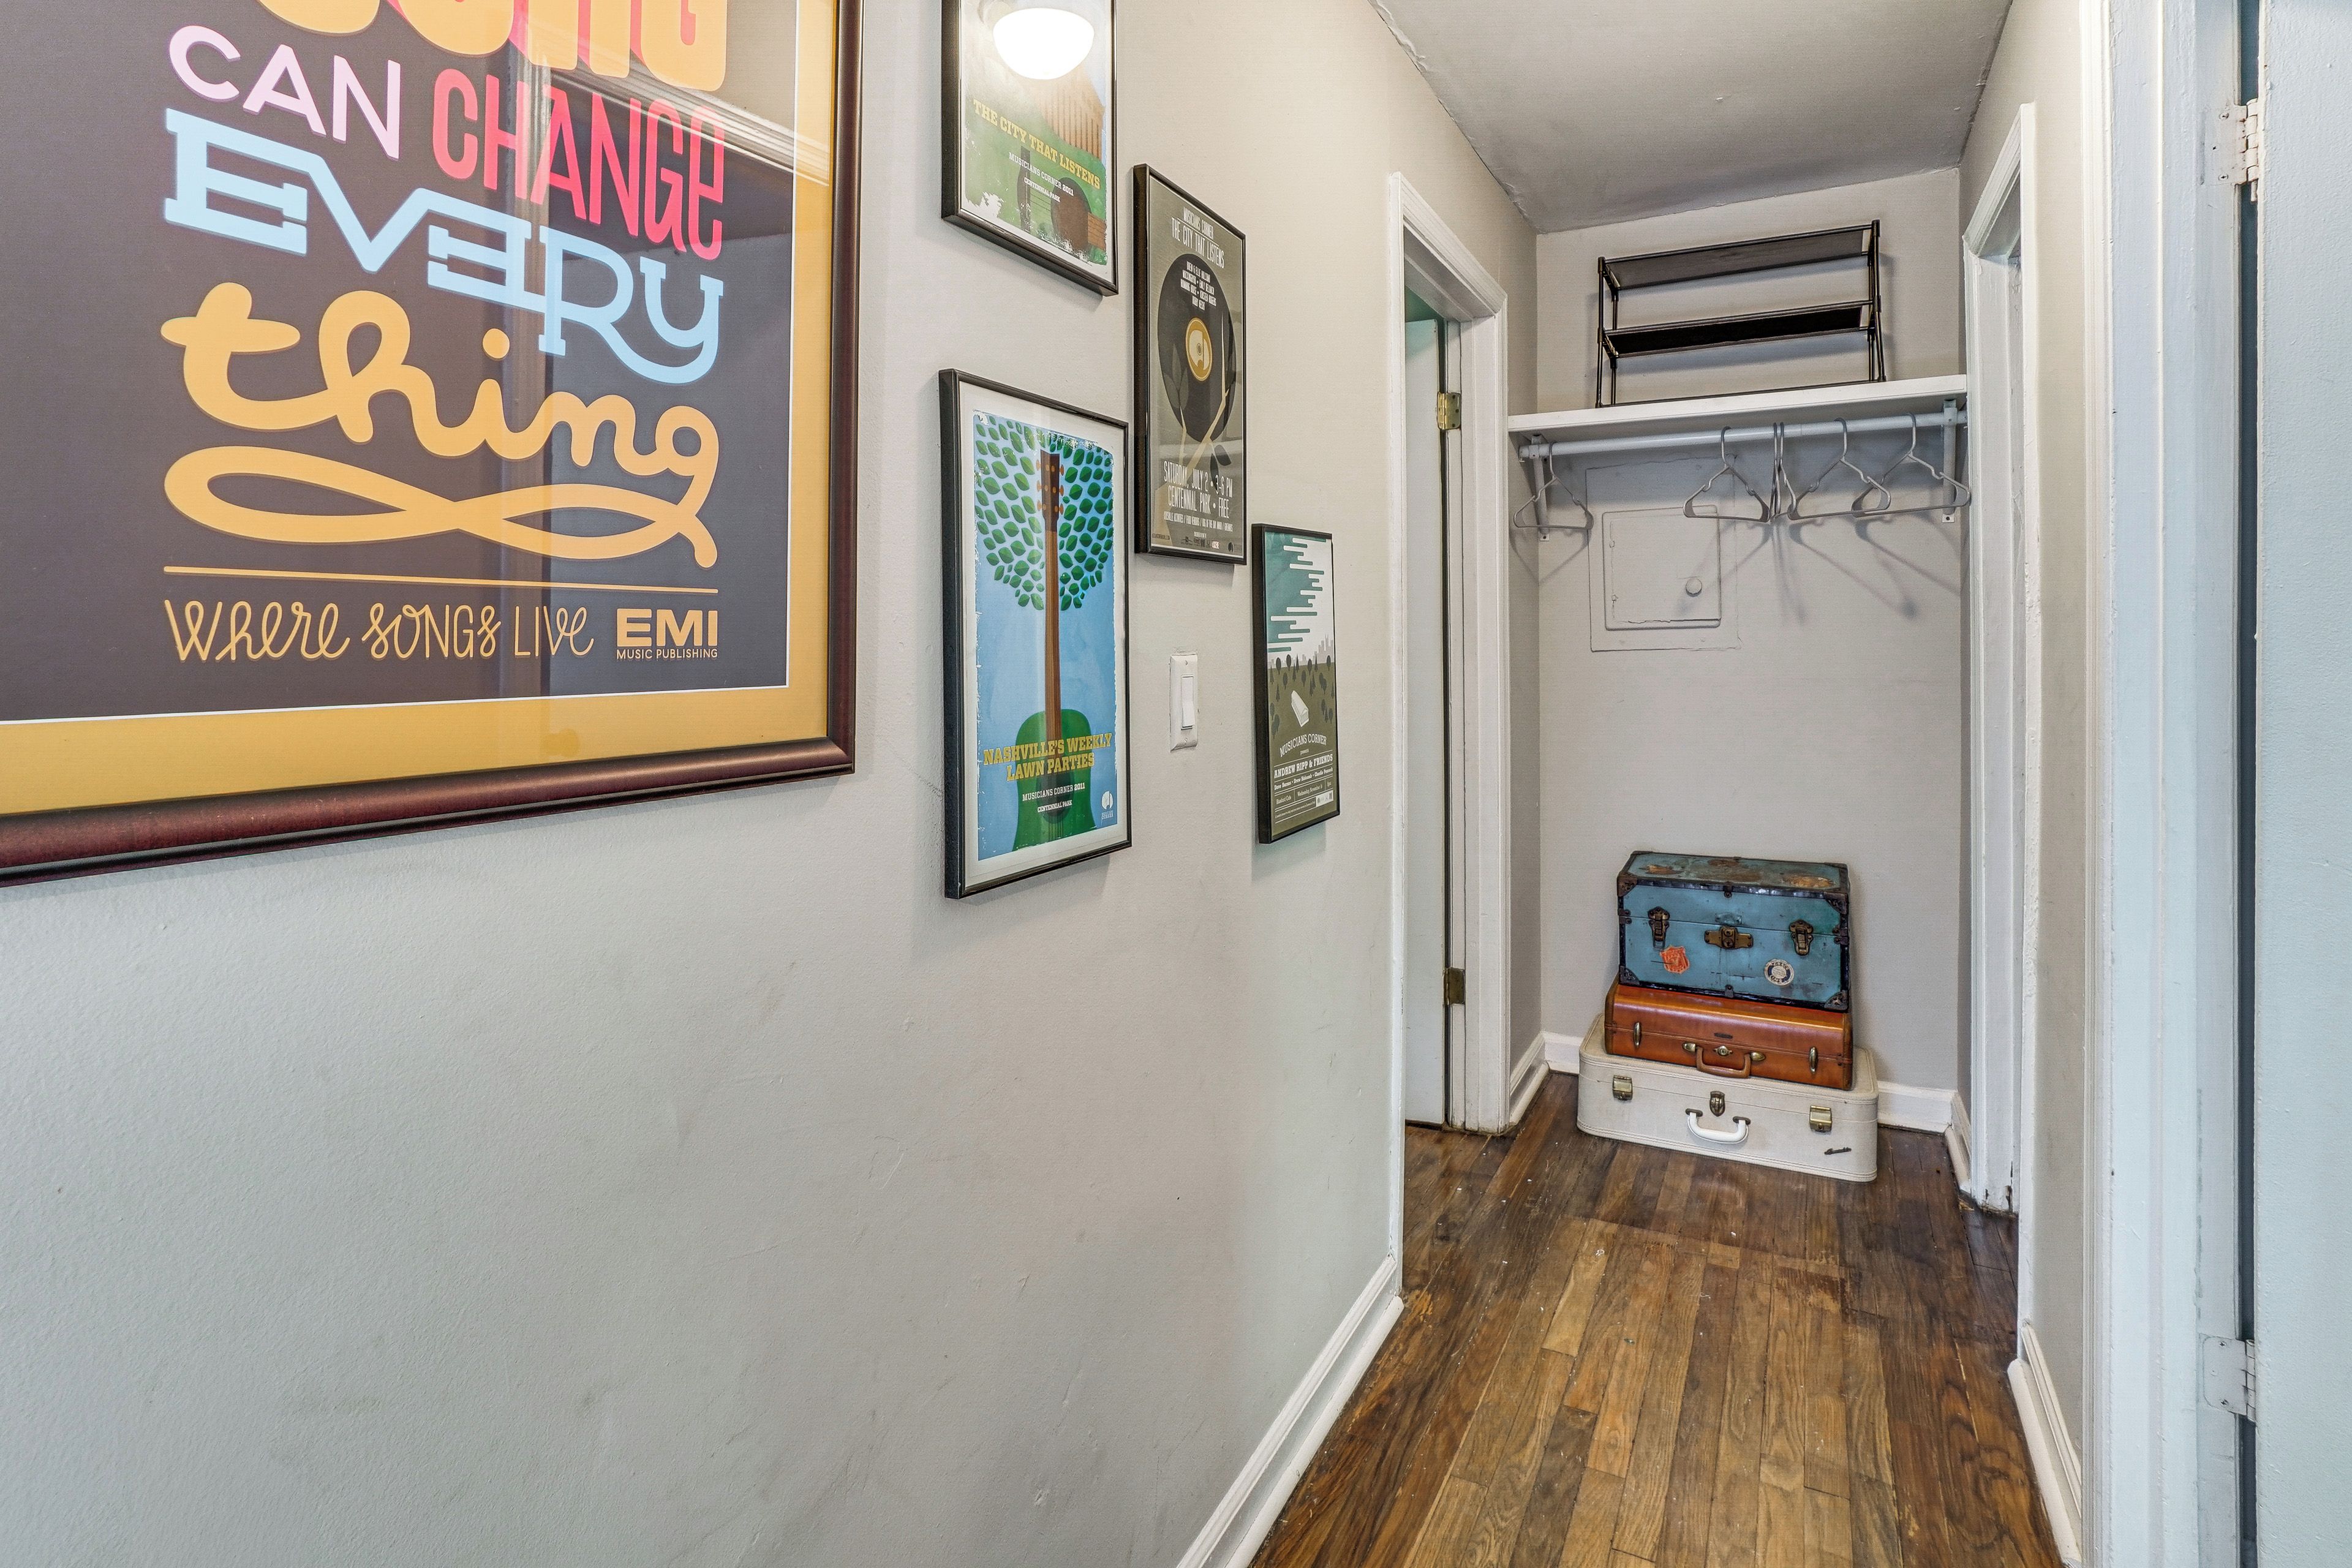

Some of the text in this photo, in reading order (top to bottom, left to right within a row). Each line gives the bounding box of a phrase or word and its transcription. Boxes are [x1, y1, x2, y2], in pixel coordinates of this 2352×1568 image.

[168, 24, 401, 160] CAN
[431, 67, 725, 260] CHANGE
[973, 99, 1101, 190] THE CITY THAT LISTENS
[1009, 152, 1074, 197] MUSICIANS CORNER 2011
[163, 107, 724, 385] EVERY
[1172, 217, 1224, 268] THE CITY THAT LISTENS
[160, 282, 720, 508] thing
[1164, 461, 1233, 499] SATURDAY, JULY 2 3-6 PM
[1169, 486, 1229, 519] CENTENNIAL PARK FREE
[617, 609, 717, 647] EMI
[617, 648, 718, 660] MUSIC PUBLISHING
[984, 733, 1113, 766] NASHVILLE'S WEEKLY
[1280, 733, 1327, 758] MUSICIANS CORNER
[1007, 753, 1095, 782] LAWN PARTIES
[1274, 754, 1333, 778] ANDREW RIPP & FRIENDS
[1022, 783, 1085, 802] MUSICIANS CORNER 2011
